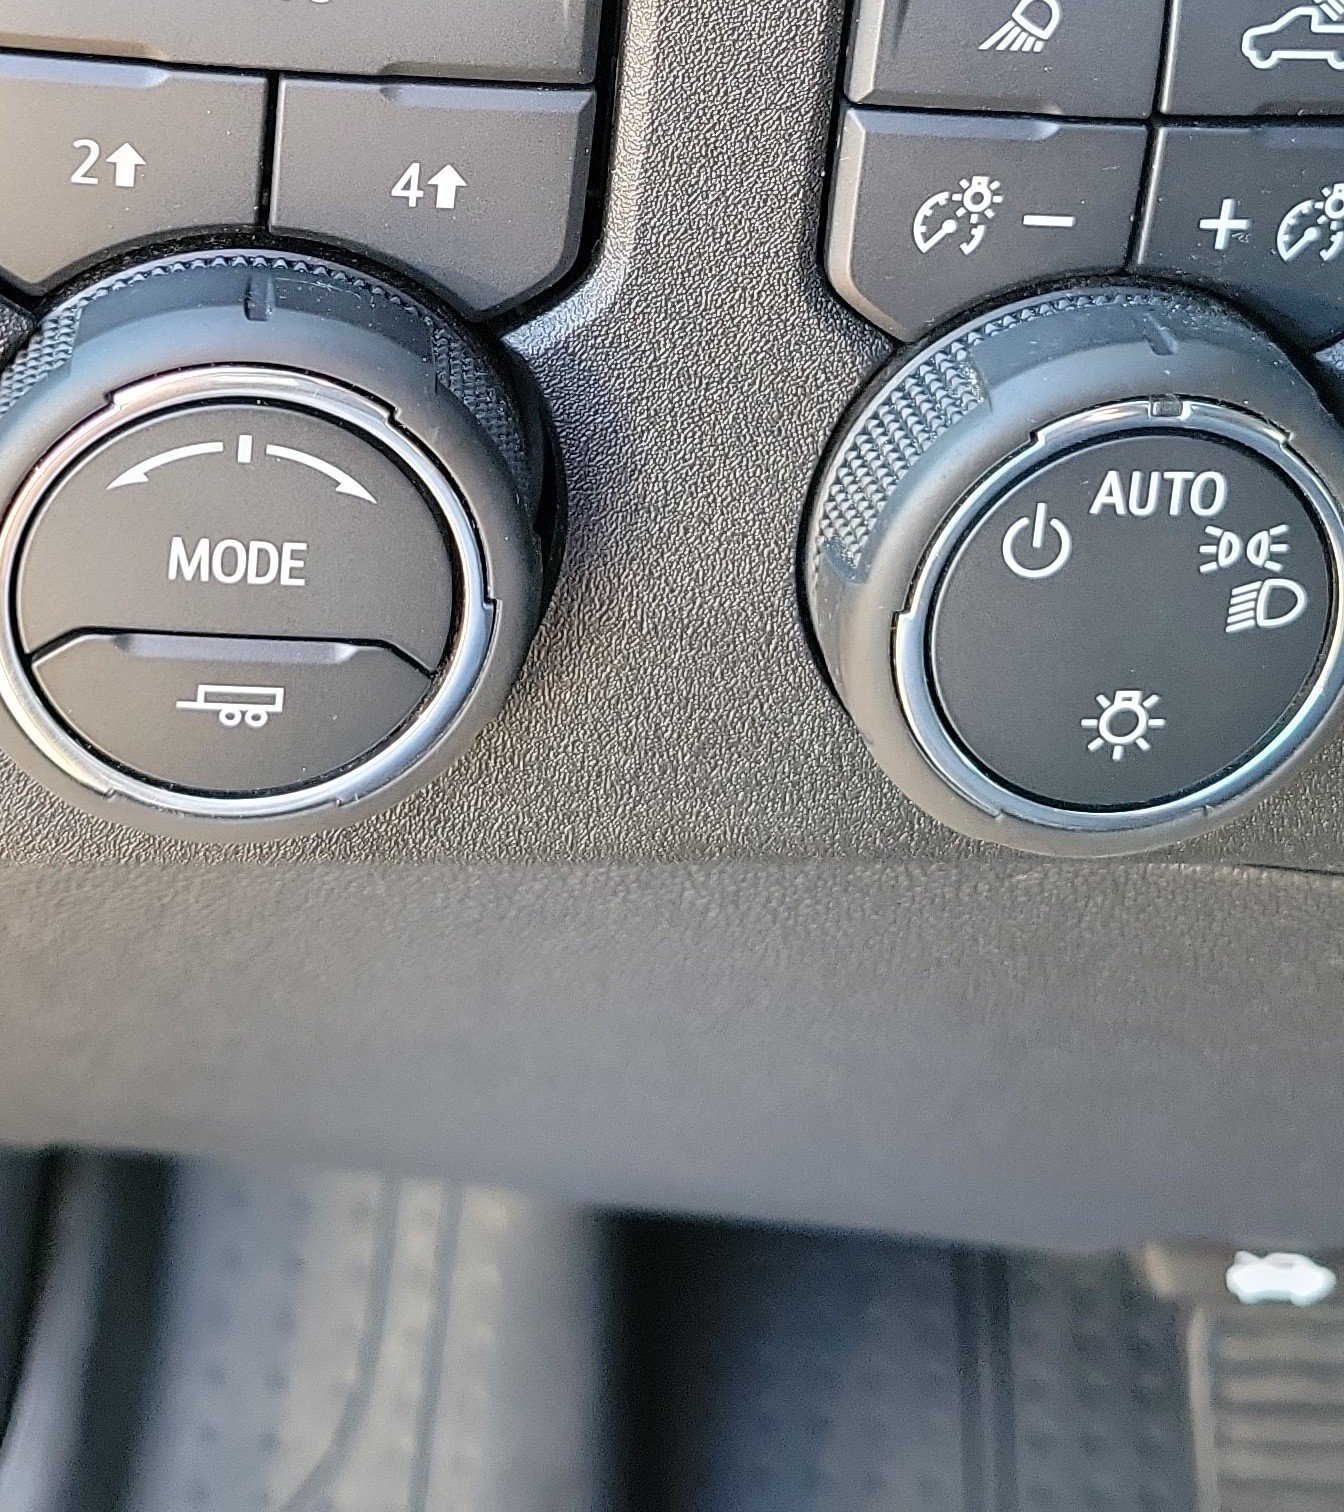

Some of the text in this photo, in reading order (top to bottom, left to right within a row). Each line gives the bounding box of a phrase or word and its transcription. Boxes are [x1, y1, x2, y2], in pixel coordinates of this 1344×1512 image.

[70, 138, 100, 185] 2
[391, 162, 424, 208] 4
[1088, 470, 1228, 517] AUTO
[167, 536, 307, 586] MODE
